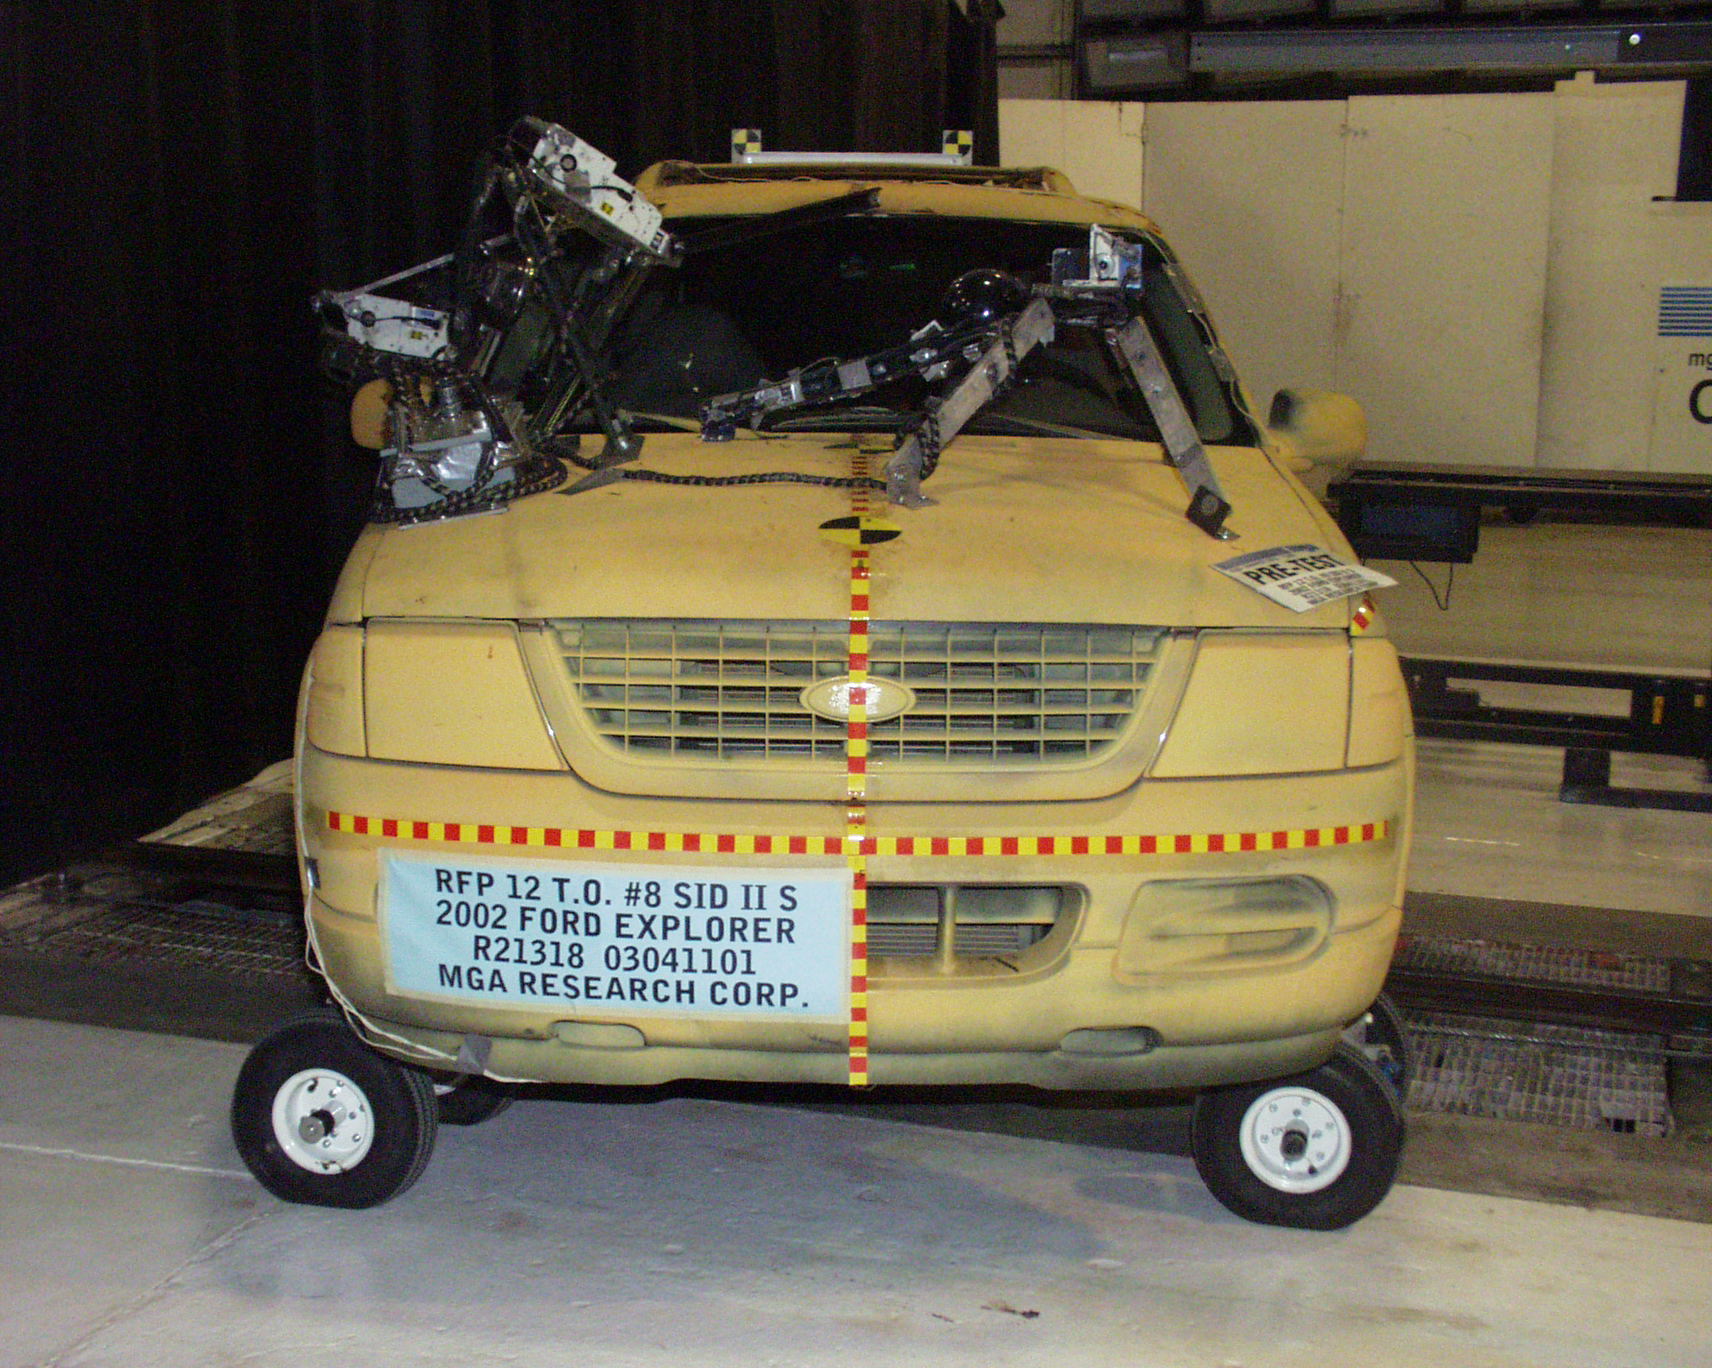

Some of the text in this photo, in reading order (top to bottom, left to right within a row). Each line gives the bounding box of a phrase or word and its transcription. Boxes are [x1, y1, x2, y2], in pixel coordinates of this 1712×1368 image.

[1243, 554, 1345, 585] PRE-TEST
[435, 868, 798, 912] RFP 12 T.O. #8 SID II S
[436, 899, 795, 944] 2002 FORD EXPLORER
[473, 934, 756, 975] R21318 03041101
[438, 963, 809, 1008] MGA RESEARCH CORP.
